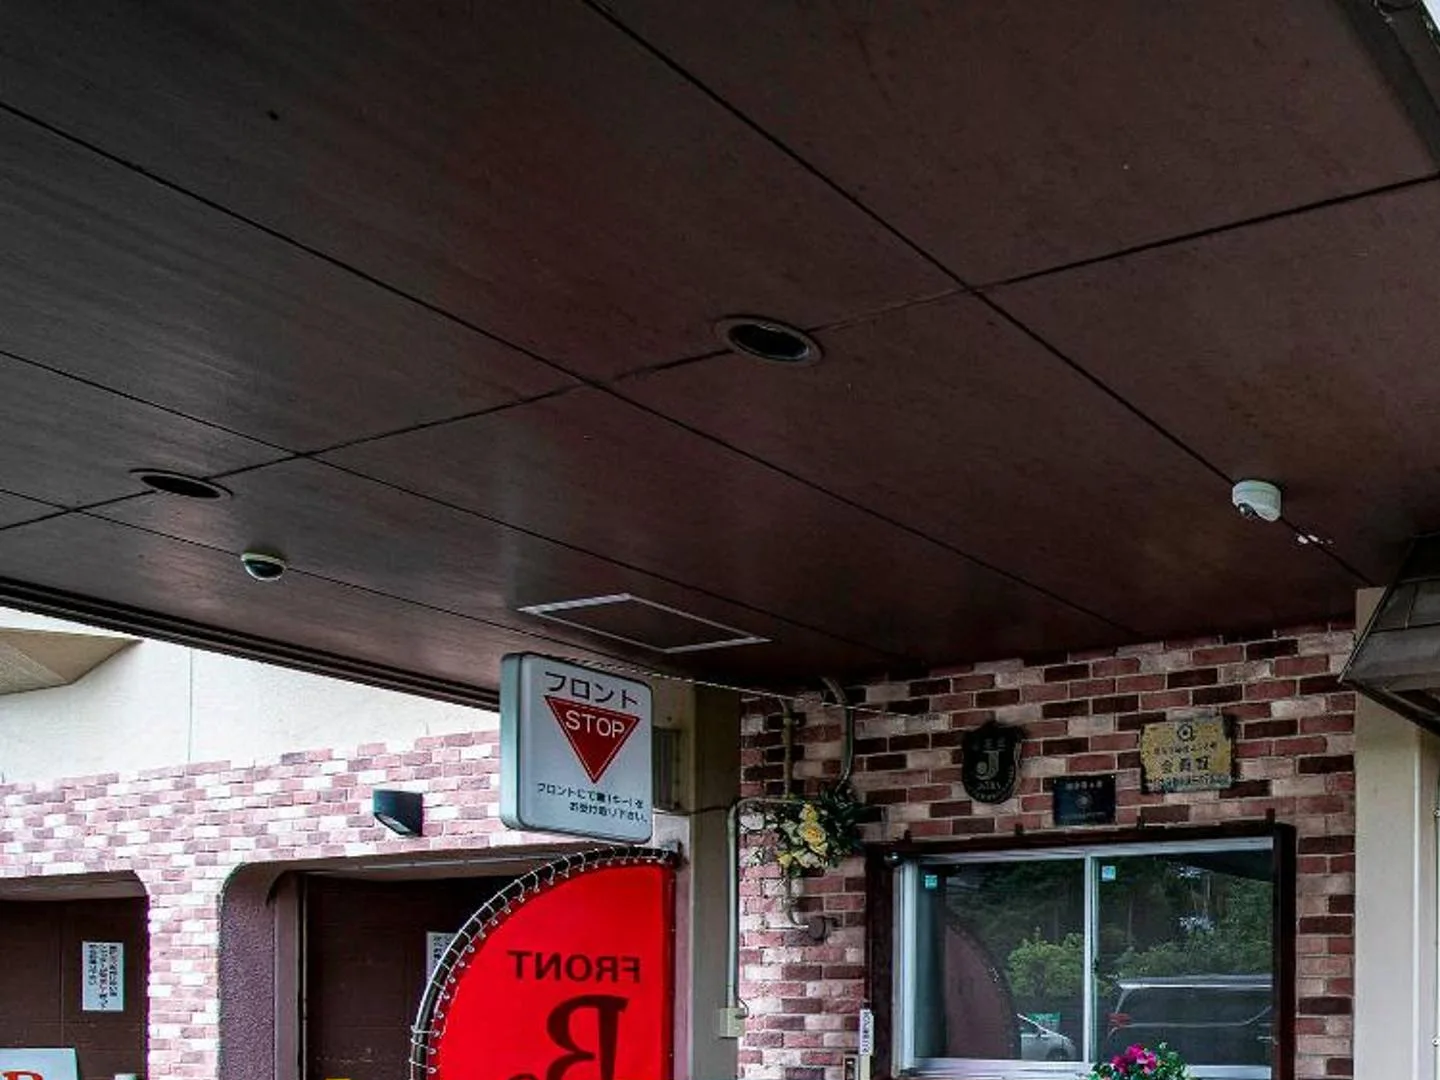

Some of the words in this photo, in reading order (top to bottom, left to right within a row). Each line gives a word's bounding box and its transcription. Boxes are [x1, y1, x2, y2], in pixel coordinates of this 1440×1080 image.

[545, 671, 639, 708] フロント
[565, 710, 625, 739] STOP
